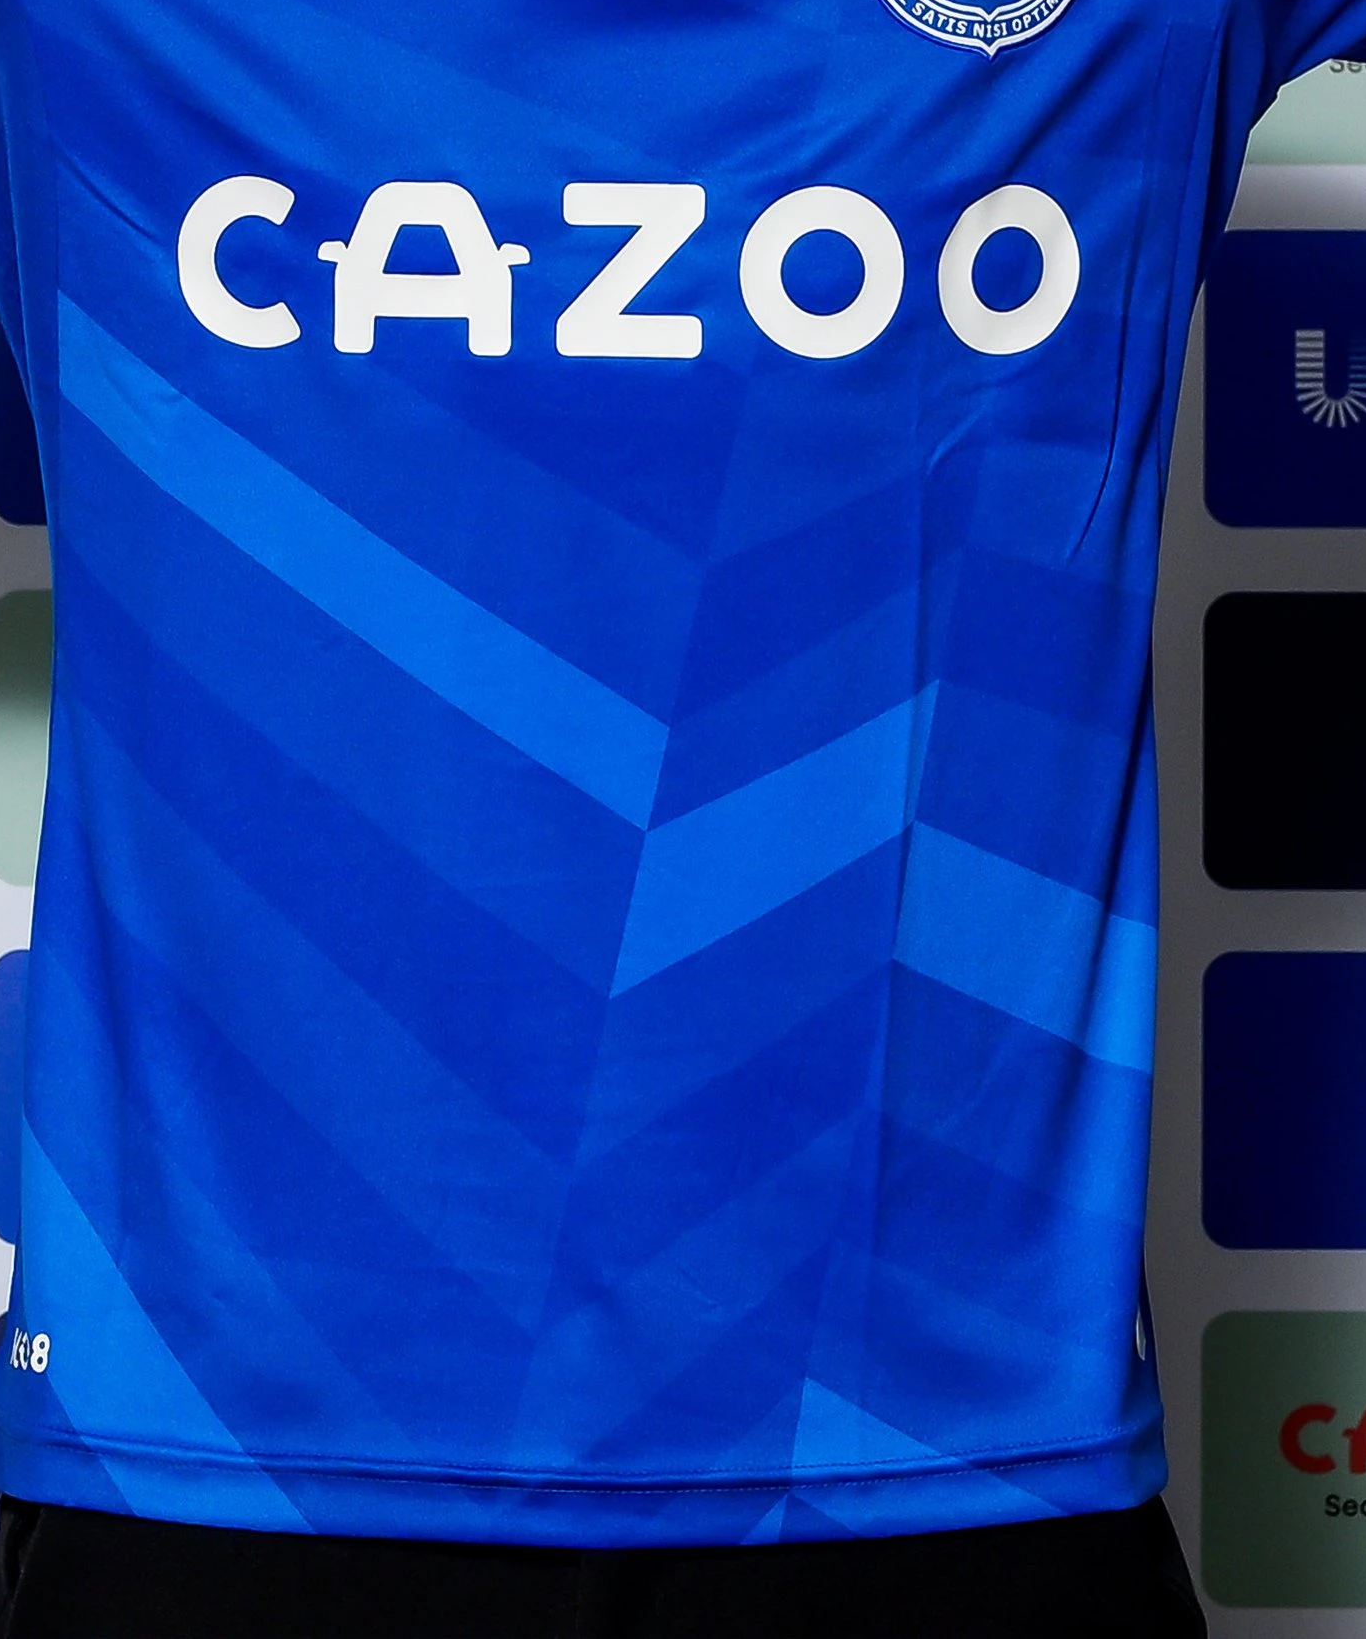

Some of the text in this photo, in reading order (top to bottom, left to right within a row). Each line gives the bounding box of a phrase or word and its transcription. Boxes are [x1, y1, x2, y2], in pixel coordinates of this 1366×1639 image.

[911, 1, 967, 35] SATIS
[973, 19, 1008, 38] NISI
[176, 174, 1081, 359] CAZOO
